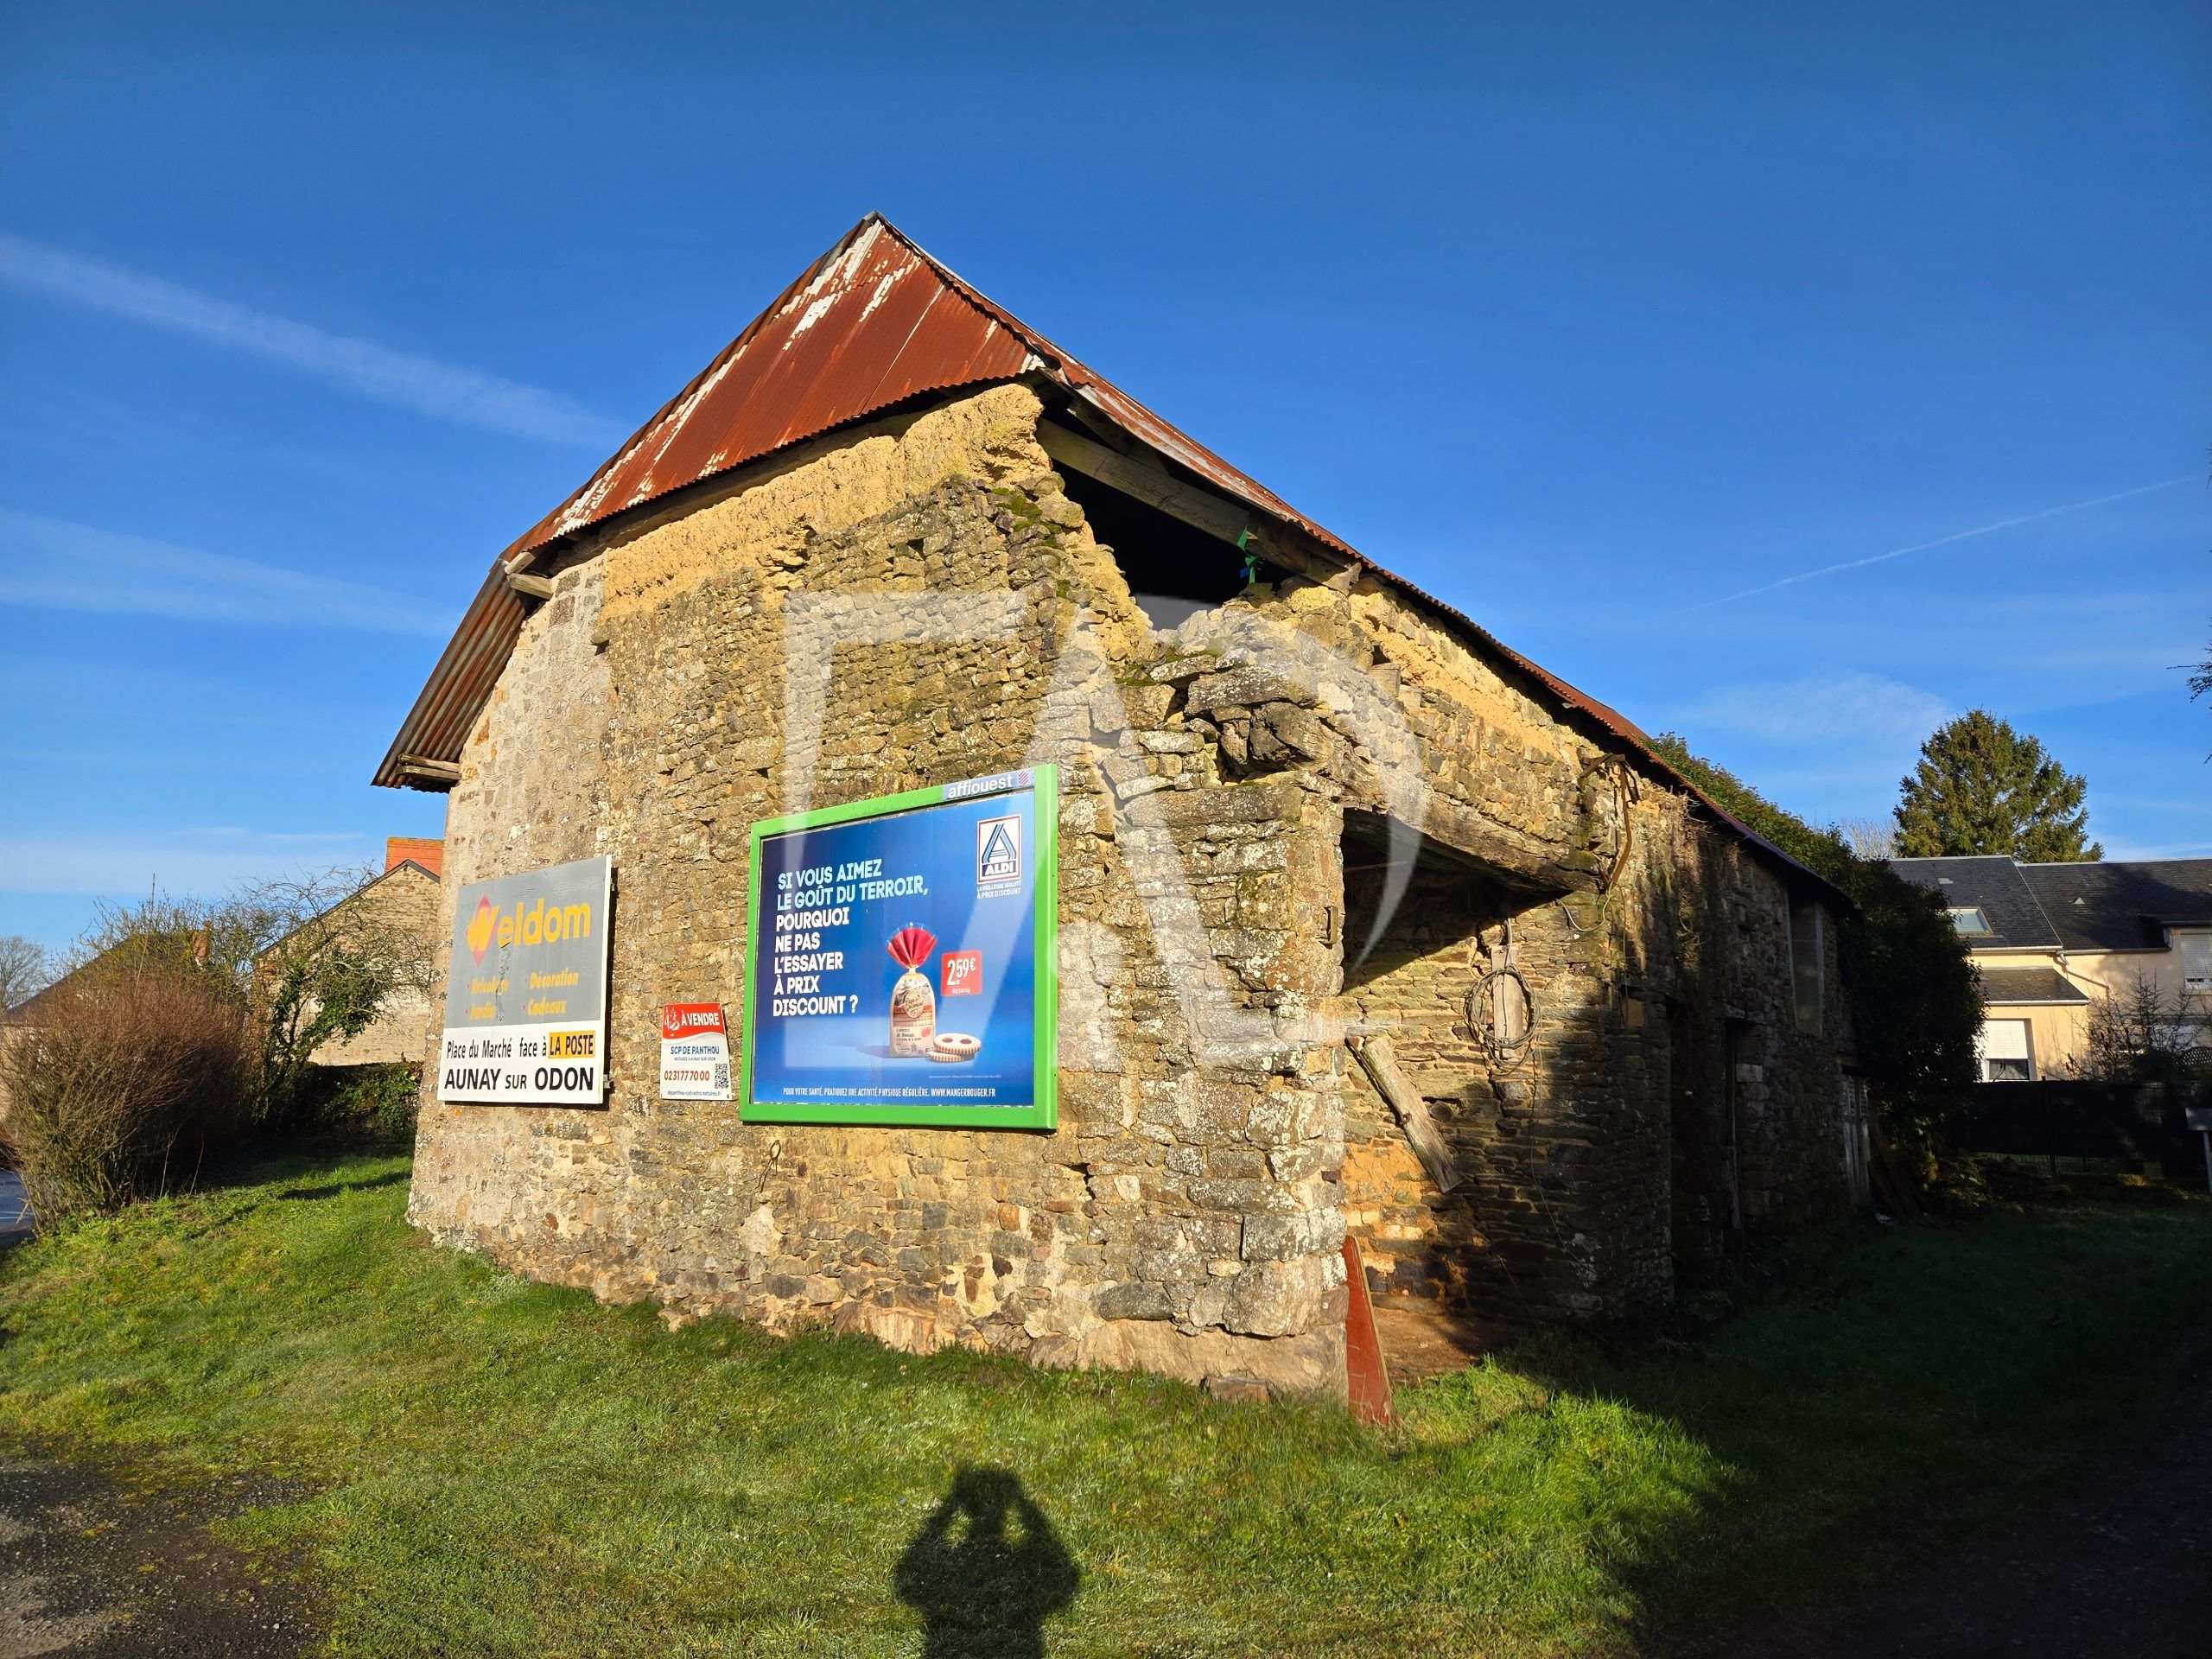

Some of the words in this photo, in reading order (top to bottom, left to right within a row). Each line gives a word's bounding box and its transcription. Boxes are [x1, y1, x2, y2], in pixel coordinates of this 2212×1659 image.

[948, 773, 1013, 798] affiouest
[778, 871, 792, 890] SI
[796, 866, 833, 887] VOUS
[836, 858, 882, 882] AIMEZ
[984, 861, 1014, 876] ALDI
[777, 893, 791, 911] LE
[794, 885, 834, 908] GOÛT
[836, 885, 855, 904] DU
[859, 875, 929, 901] TERROIR,
[776, 906, 849, 932] POURQUOI
[775, 934, 792, 953] NE
[794, 931, 820, 950] PAS
[774, 951, 843, 975] L'ESSAYER
[529, 968, 579, 989] Décoration
[773, 974, 785, 995] À
[786, 975, 820, 994] PRIX
[527, 996, 567, 1015] Cadeaux
[772, 995, 847, 1017] DISCOUNT
[849, 995, 859, 1014] ?
[687, 1012, 720, 1027] VENDRE
[447, 1040, 466, 1058] Place
[468, 1039, 479, 1058] du
[481, 1037, 512, 1058] Marché
[519, 1036, 537, 1058] face
[542, 1036, 547, 1058] à
[550, 1036, 561, 1056] LA
[565, 1034, 594, 1056] POSTE
[692, 1046, 720, 1054] PANTHOU
[444, 1068, 501, 1090] AUNAY
[505, 1074, 527, 1089] SUR
[534, 1067, 594, 1090] ODON
[848, 1088, 857, 1096] UNE
[857, 1086, 878, 1096] ACTIVITÉ
